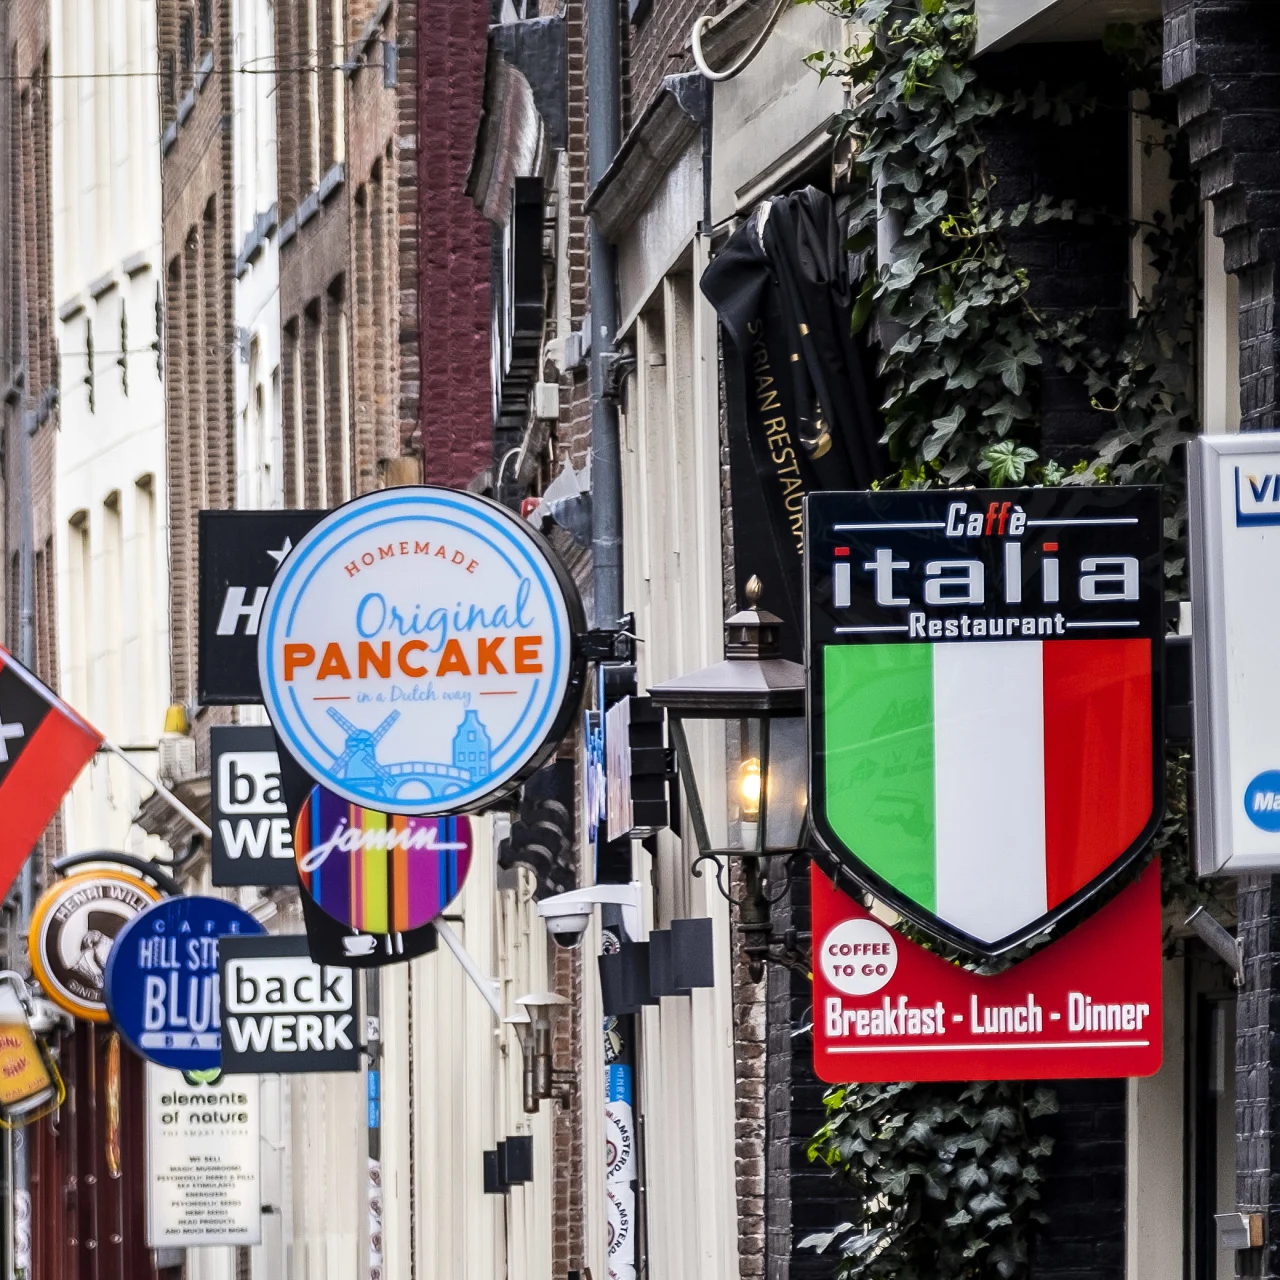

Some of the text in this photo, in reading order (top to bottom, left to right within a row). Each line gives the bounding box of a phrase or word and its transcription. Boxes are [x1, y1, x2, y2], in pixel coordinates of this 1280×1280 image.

[747, 317, 782, 412] SYRIAN
[945, 501, 1028, 537] Caffè
[344, 540, 480, 577] HOMEMADE
[834, 541, 1141, 608] italia
[356, 577, 535, 653] Original
[908, 611, 1066, 638] Restaurant
[283, 634, 544, 681] PANCAKE
[390, 681, 436, 702] Dutch
[443, 690, 473, 708] way
[300, 817, 468, 873] jamin
[139, 936, 182, 970] HILL
[828, 942, 891, 957] COFFEE
[236, 970, 344, 1006] back
[832, 963, 888, 978] TO GO
[825, 995, 947, 1038] Breakfast
[971, 993, 1043, 1034] Lunch
[1067, 991, 1150, 1032] Dinner
[226, 1014, 354, 1052] WERK
[160, 1090, 249, 1107] elements
[161, 1111, 249, 1125] of nature
